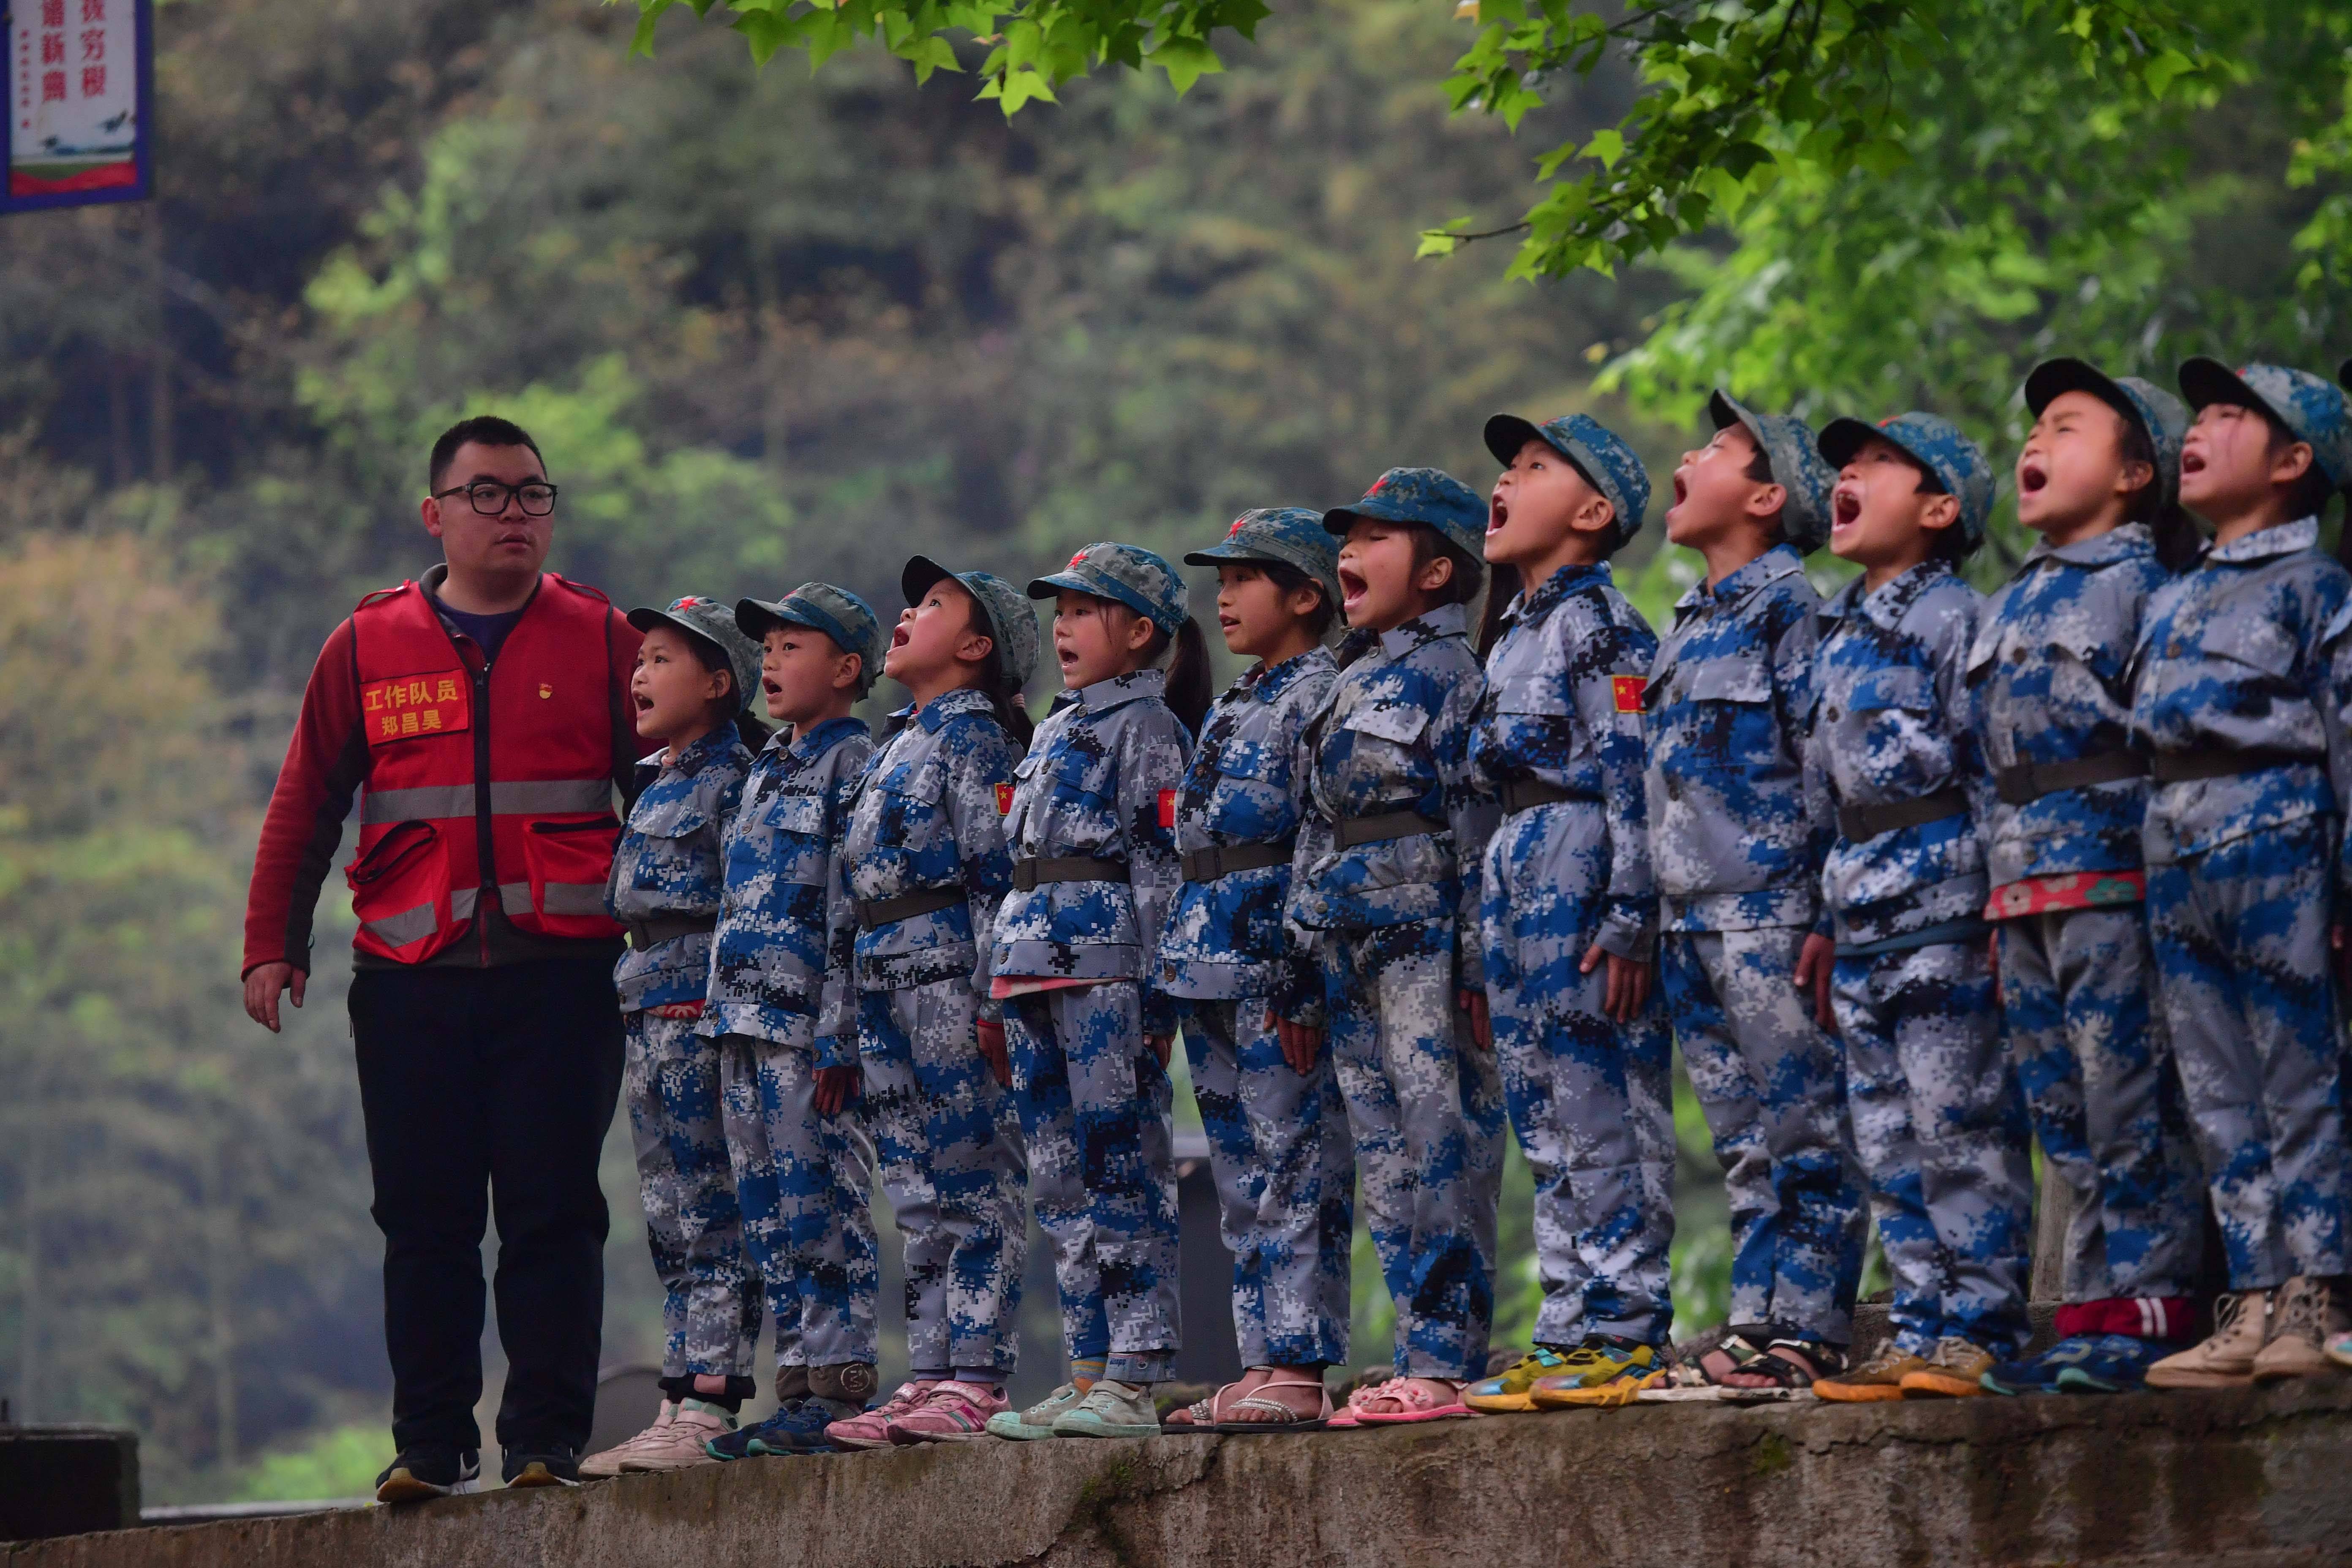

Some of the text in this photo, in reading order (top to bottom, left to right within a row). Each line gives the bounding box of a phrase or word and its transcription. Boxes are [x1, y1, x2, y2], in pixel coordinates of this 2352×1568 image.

[365, 679, 458, 712] 工作队员
[381, 709, 442, 736] 郑昌昊
